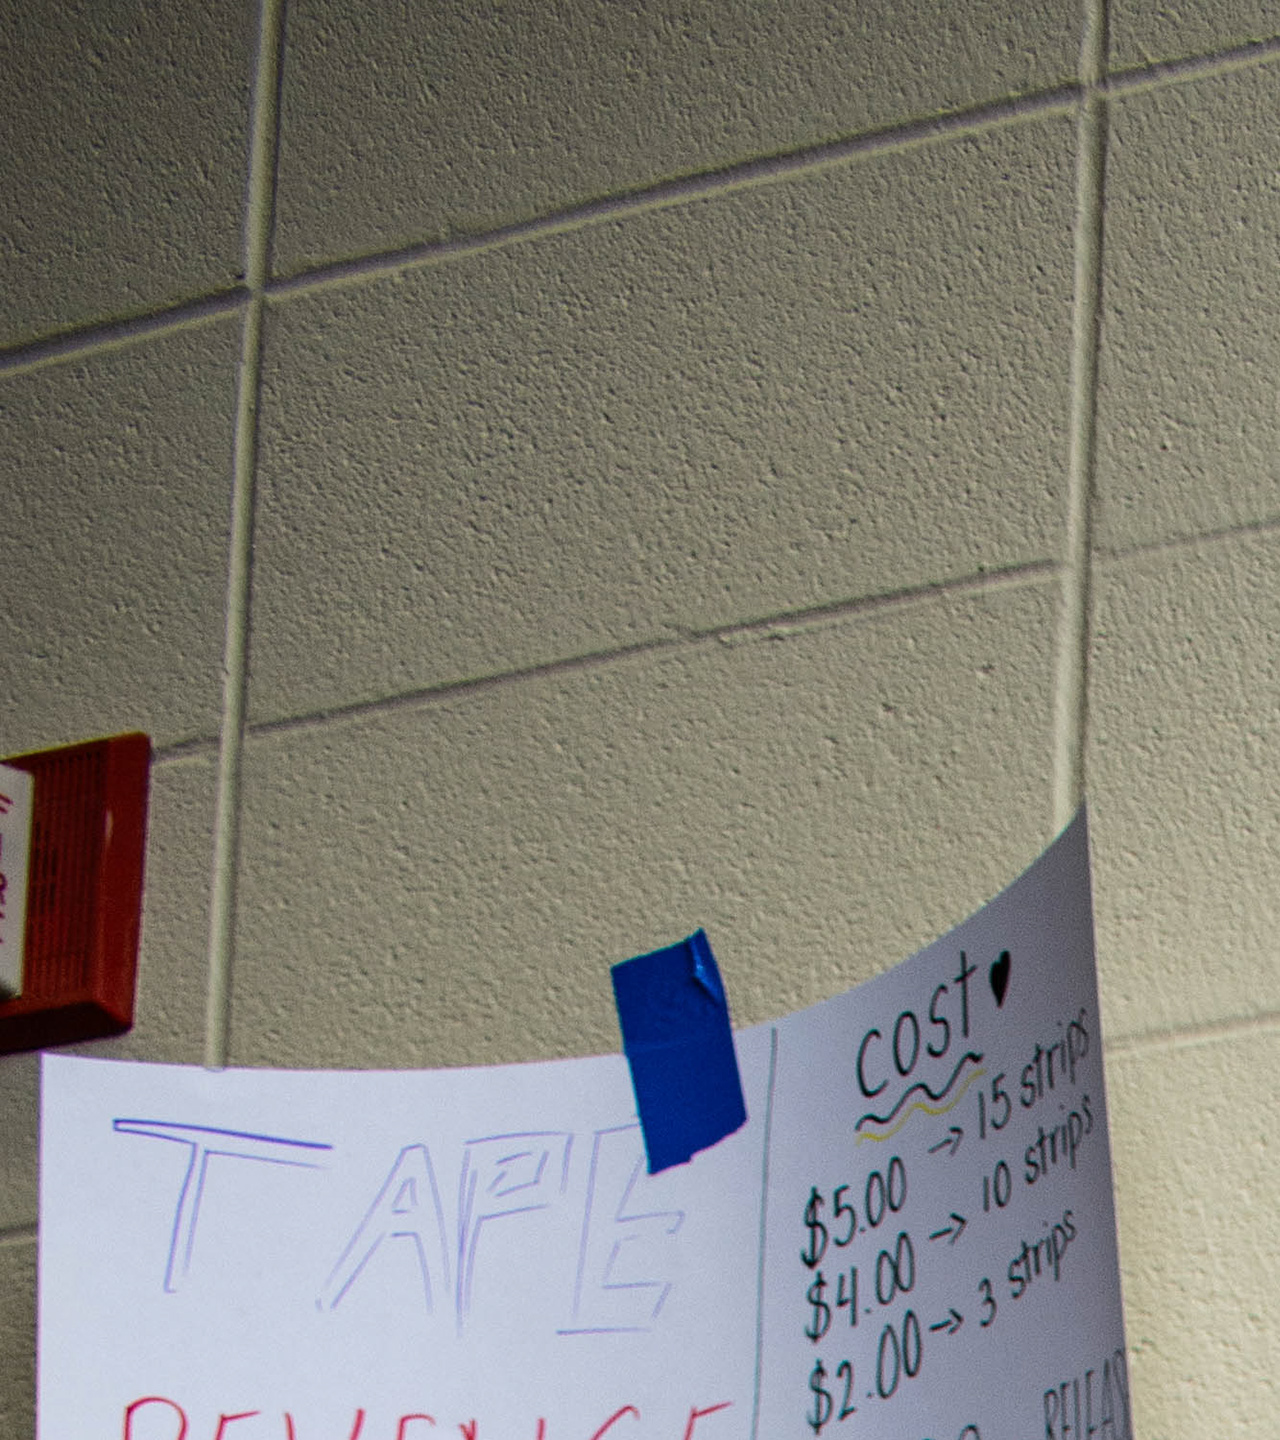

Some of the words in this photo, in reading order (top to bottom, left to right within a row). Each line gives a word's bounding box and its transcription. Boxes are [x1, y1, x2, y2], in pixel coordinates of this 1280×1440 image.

[112, 1116, 688, 1340] TAPE
[802, 1156, 907, 1268] $5.00
[979, 1073, 1012, 1140] 15
[1022, 1006, 1091, 1108] strips
[806, 1232, 916, 1343] $4.00
[983, 1160, 1012, 1212] 10
[1024, 1094, 1093, 1185] strips
[807, 1310, 922, 1435] $2.00
[979, 1277, 997, 1327] 3
[1007, 1209, 1078, 1298] strips
